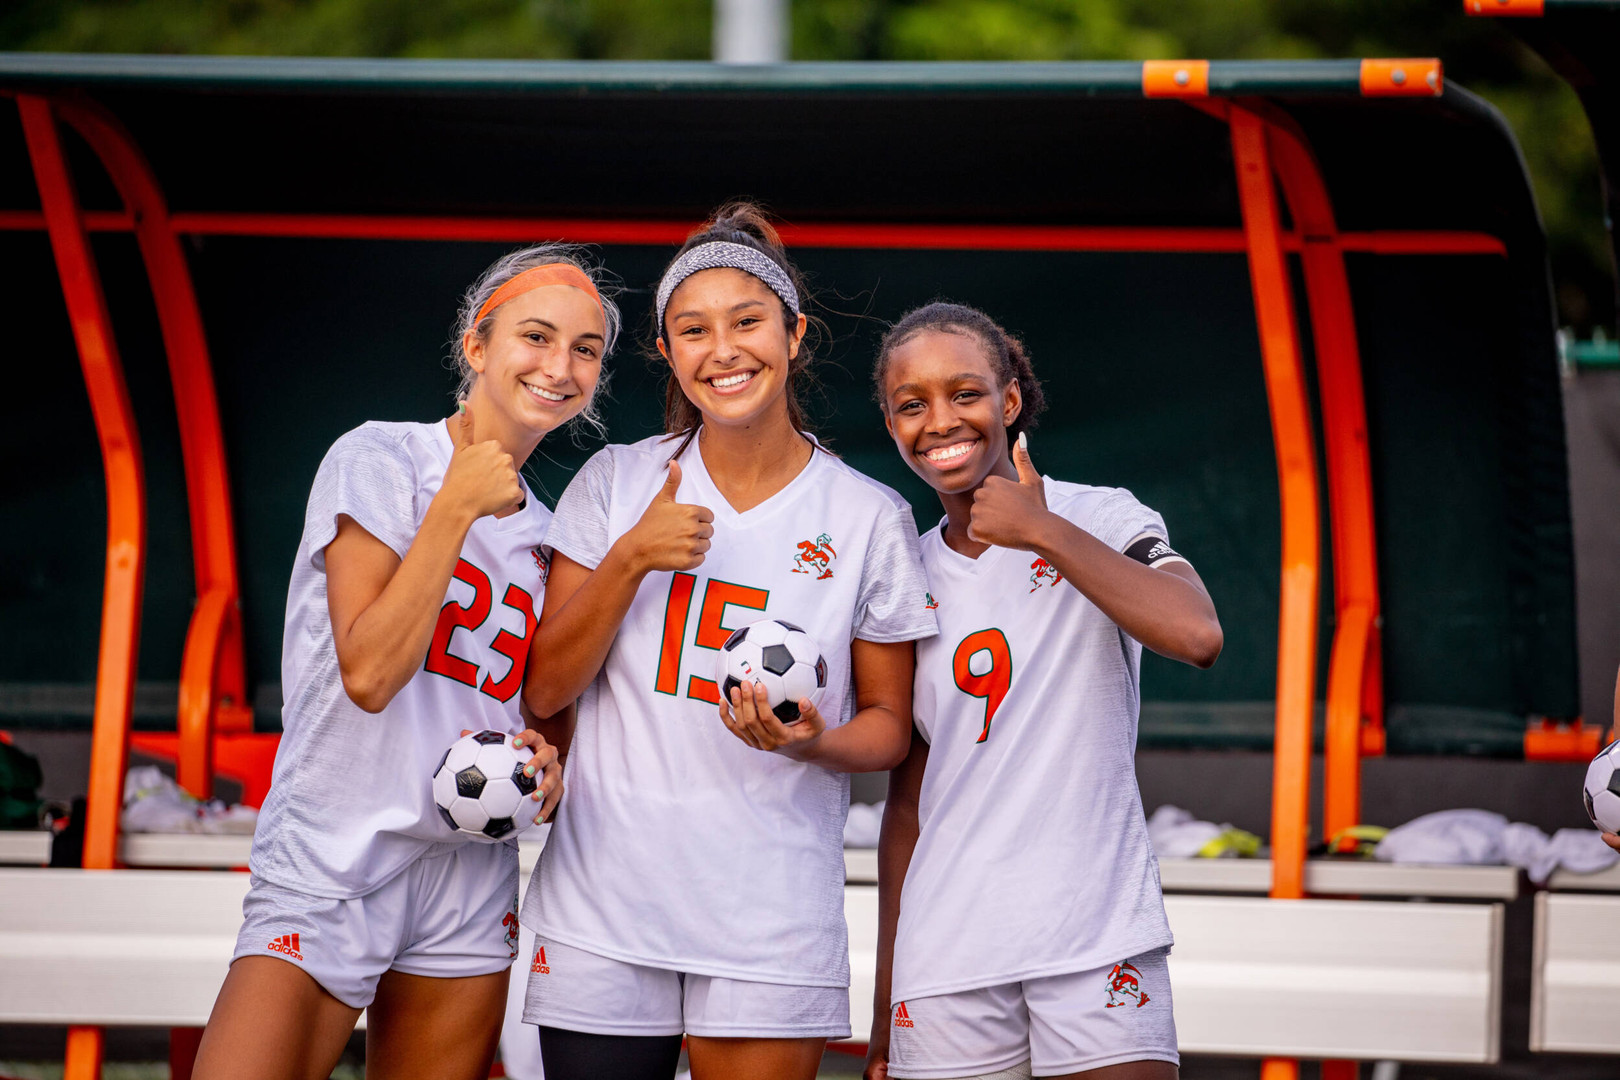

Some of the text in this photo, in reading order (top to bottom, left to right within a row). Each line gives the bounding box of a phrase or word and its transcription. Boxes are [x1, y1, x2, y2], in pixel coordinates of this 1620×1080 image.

[424, 557, 539, 704] 23
[654, 571, 770, 706] 15
[953, 627, 1013, 744] 9
[267, 942, 304, 961] adidas
